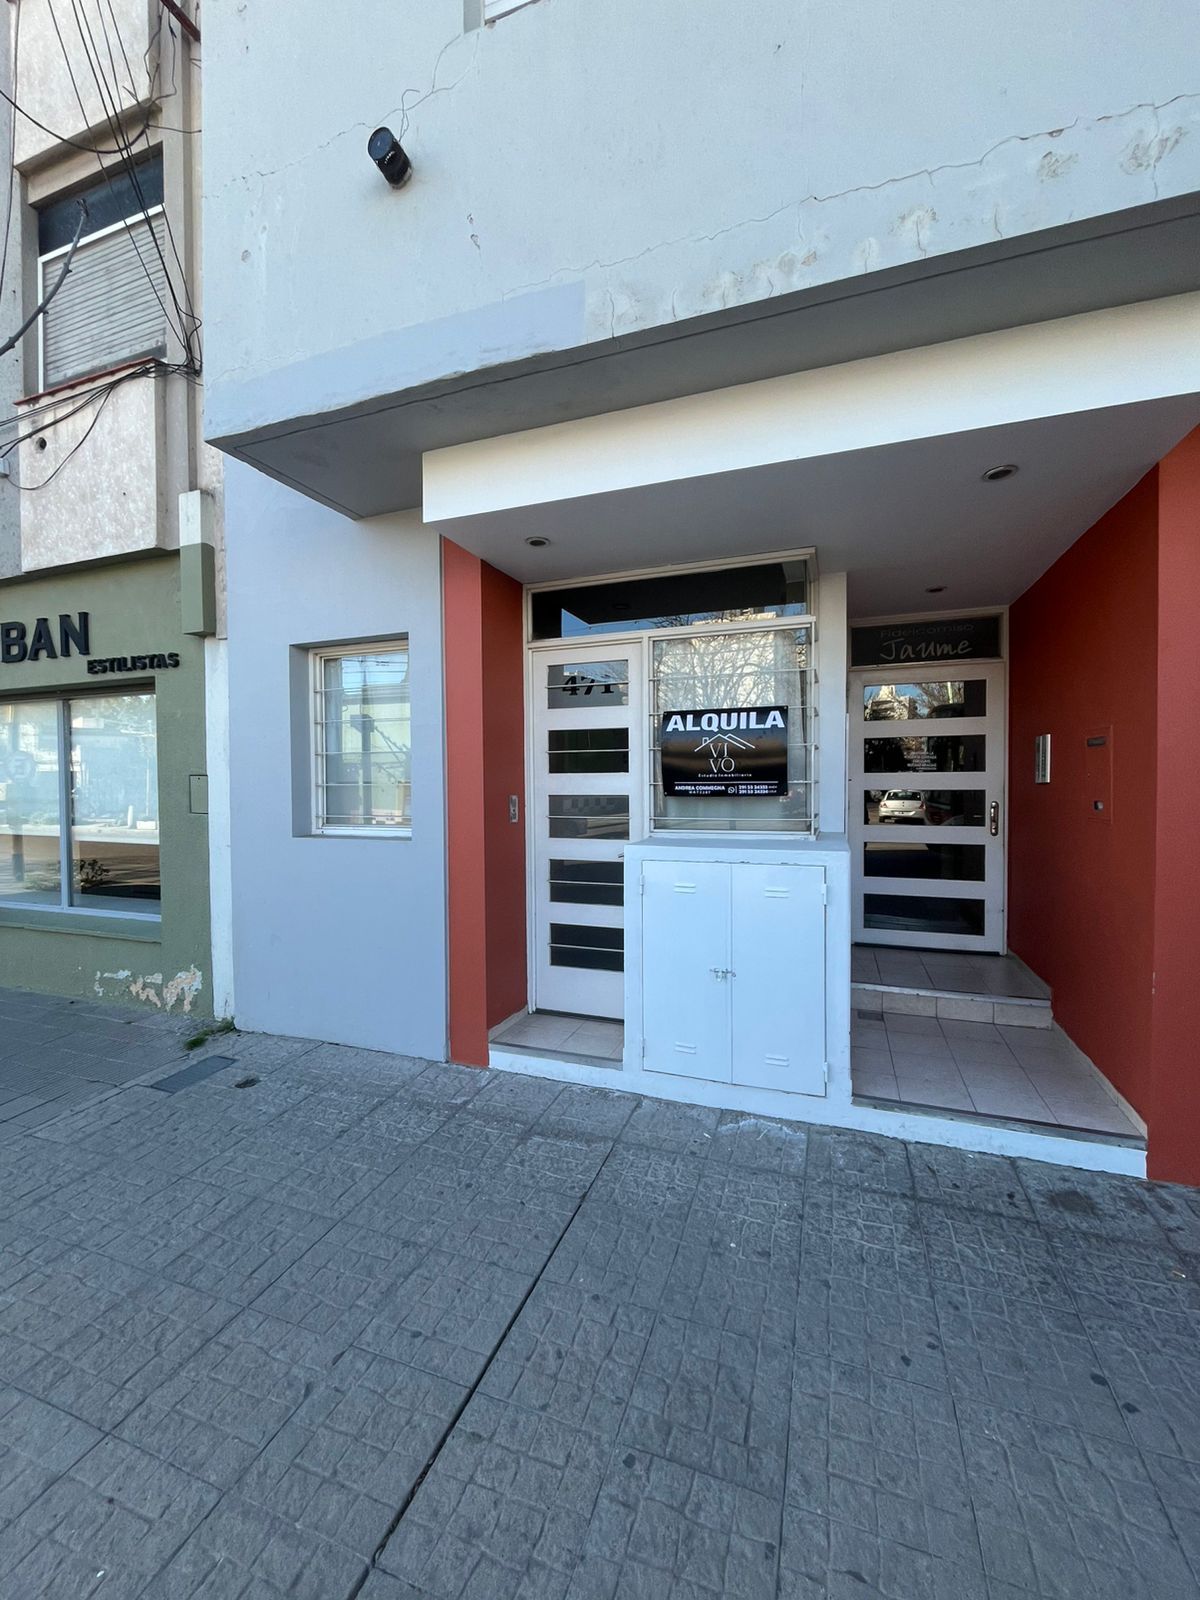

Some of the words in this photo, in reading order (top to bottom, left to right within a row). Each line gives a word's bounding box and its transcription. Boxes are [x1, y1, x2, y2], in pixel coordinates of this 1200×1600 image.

[0, 611, 90, 663] BAN
[87, 653, 180, 674] ESTILISTAS
[562, 674, 614, 696] 471
[666, 710, 785, 732] ALQUILA
